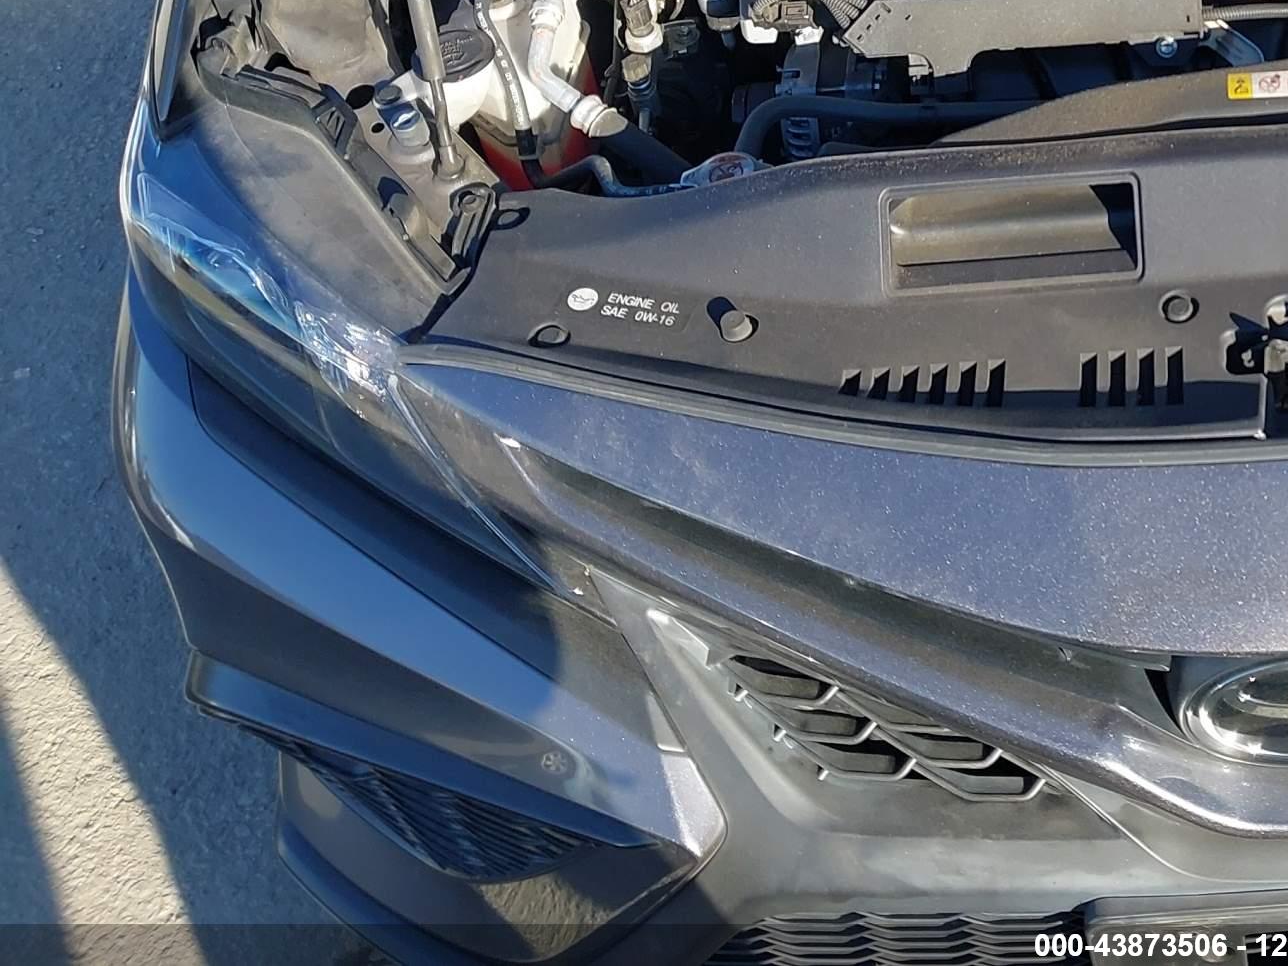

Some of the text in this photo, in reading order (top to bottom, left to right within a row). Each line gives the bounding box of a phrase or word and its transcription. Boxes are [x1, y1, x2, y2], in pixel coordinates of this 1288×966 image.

[607, 293, 680, 314] ENGINE OIL
[600, 305, 676, 326] SAE 0W-16
